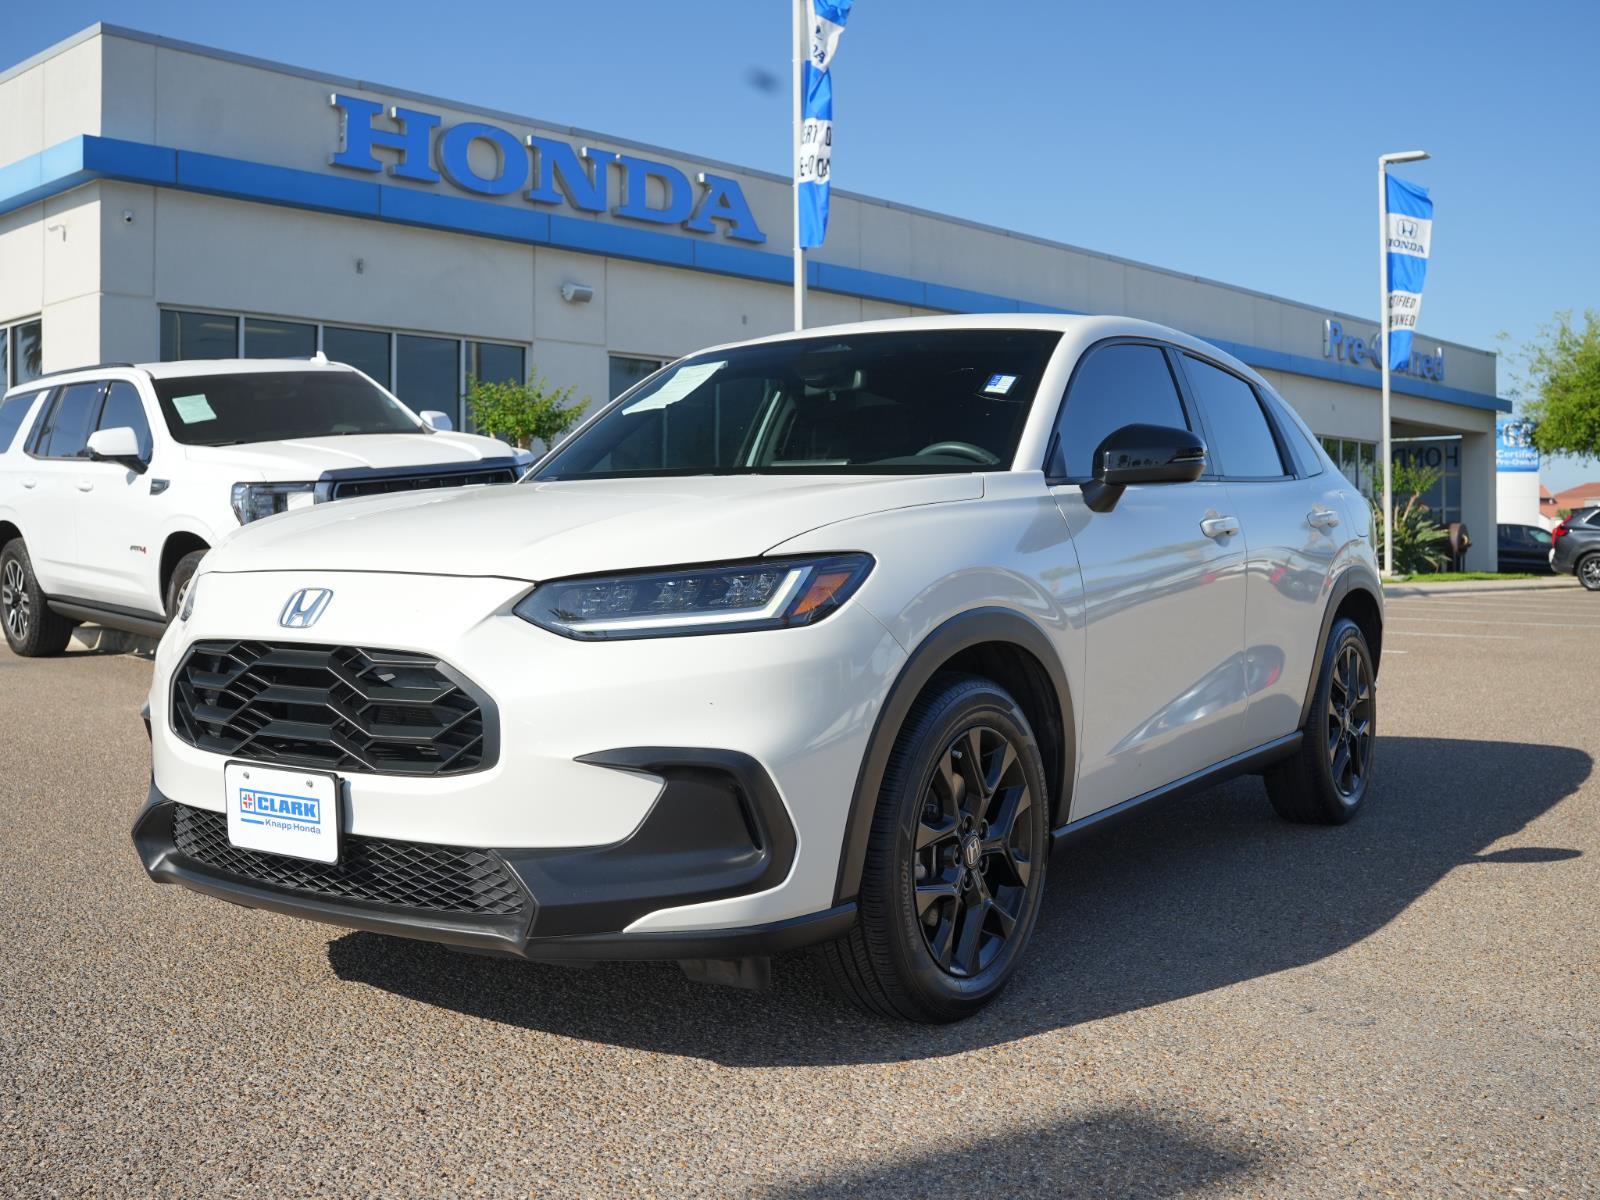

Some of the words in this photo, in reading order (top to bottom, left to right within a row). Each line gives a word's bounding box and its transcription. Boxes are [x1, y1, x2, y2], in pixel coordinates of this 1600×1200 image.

[329, 93, 767, 244] HONDA
[1323, 319, 1444, 381] Pre-ned
[257, 796, 316, 818] CLARK
[265, 818, 292, 831] Knapp
[293, 823, 321, 835] Honda
